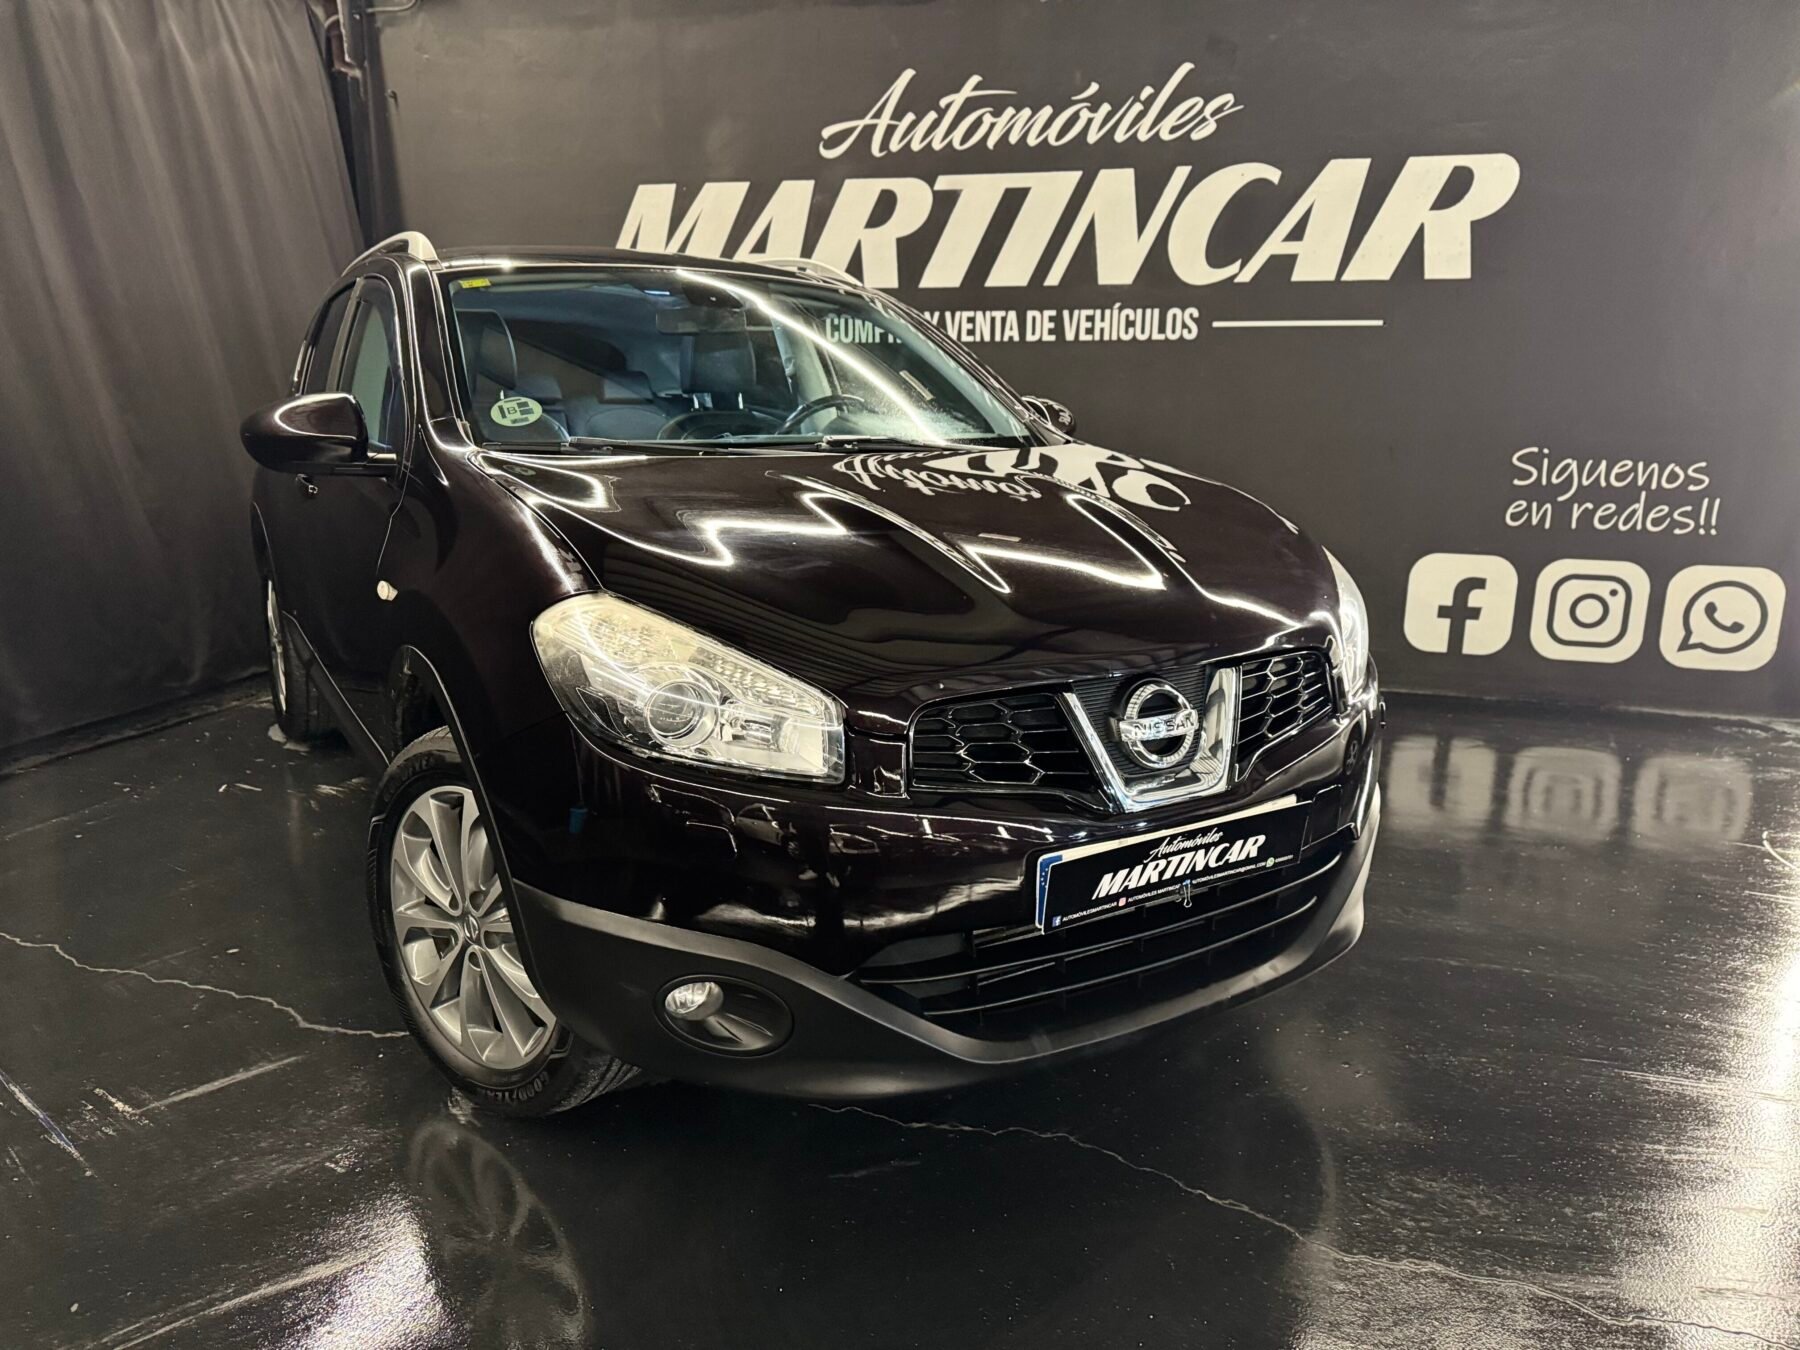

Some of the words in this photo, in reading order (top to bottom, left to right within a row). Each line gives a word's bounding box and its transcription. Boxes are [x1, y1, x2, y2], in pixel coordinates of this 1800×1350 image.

[819, 61, 1244, 160] Automóviles
[615, 152, 1521, 289] MARTINCAR
[825, 313, 902, 344] COMP
[945, 310, 1019, 343] VENTA
[1025, 310, 1056, 342] DE
[1063, 302, 1199, 342] VEHÍCULOS
[1511, 446, 1710, 502] Siguenos
[1504, 500, 1553, 530] en
[1571, 490, 1721, 536] redes!!
[1134, 716, 1195, 737] NISSAN
[1092, 834, 1267, 900] MARTINCAR
[1143, 827, 1224, 864] Automóviles
